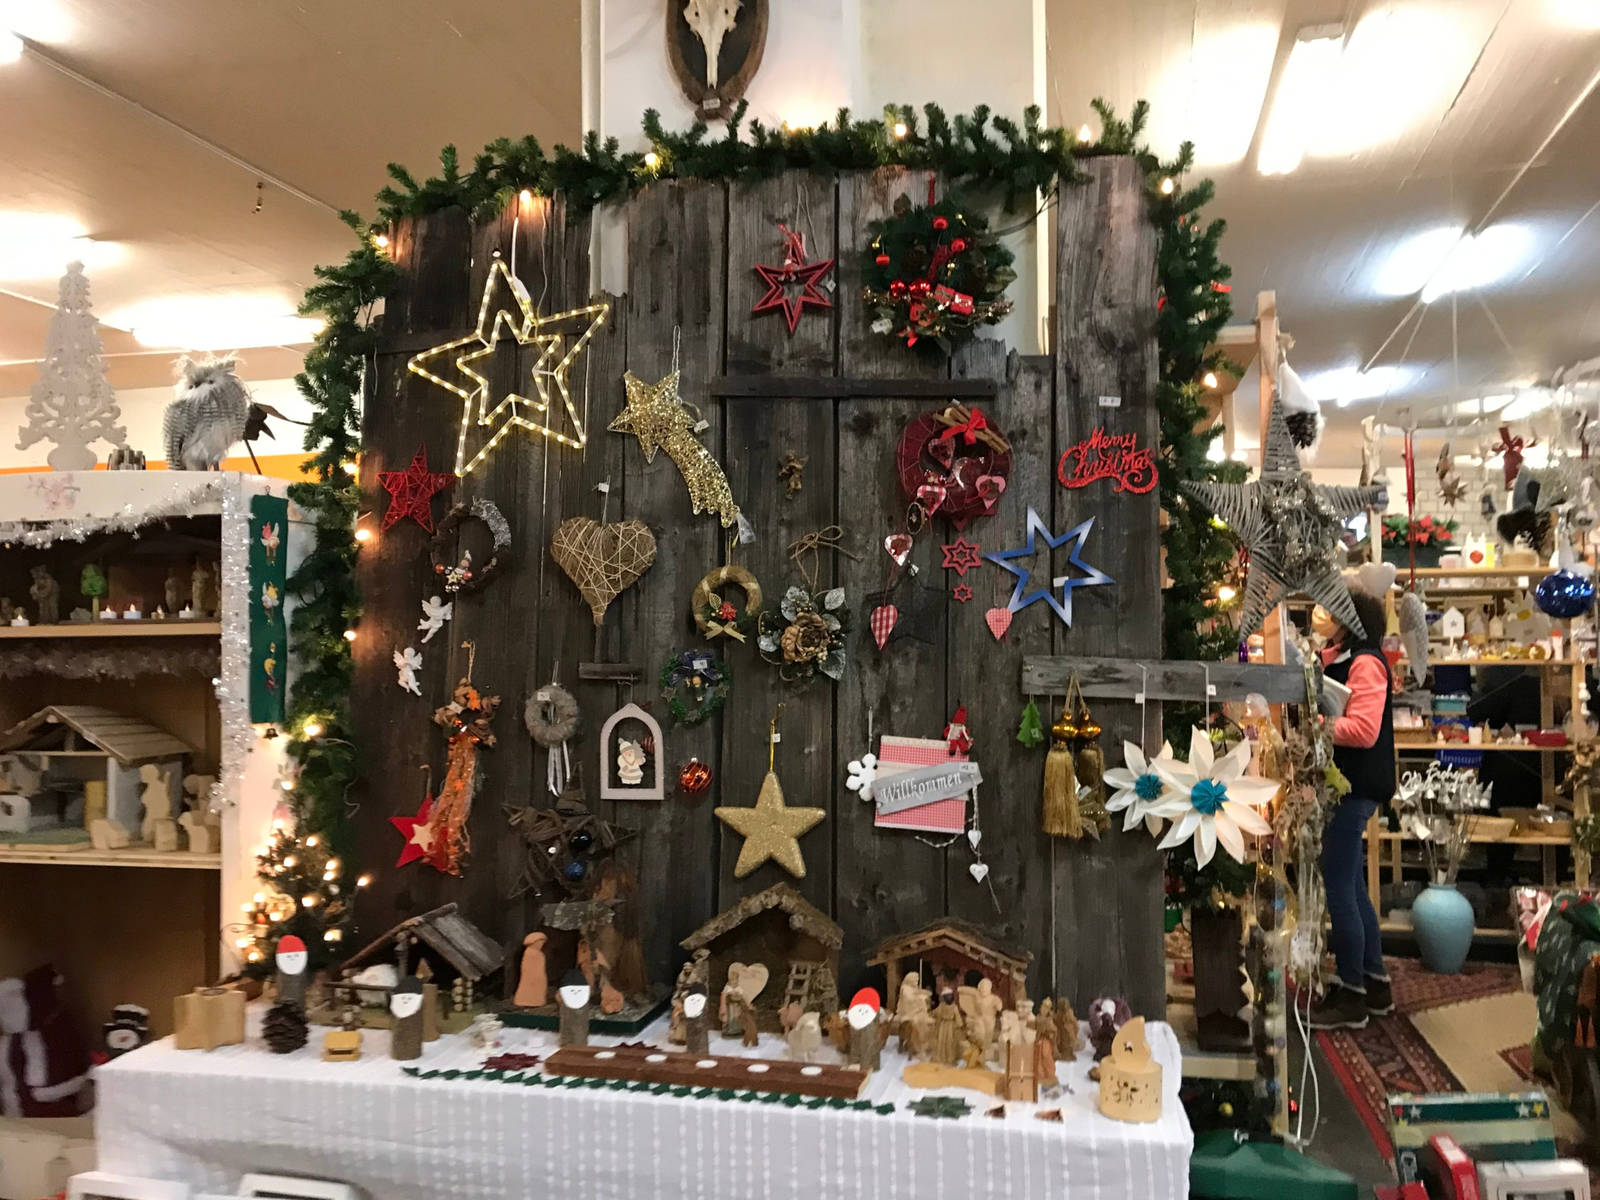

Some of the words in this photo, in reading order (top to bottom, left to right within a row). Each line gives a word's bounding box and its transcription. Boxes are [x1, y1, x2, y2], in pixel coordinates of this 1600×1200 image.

[1087, 425, 1137, 461] Merry
[1057, 441, 1159, 494] Christmas
[880, 771, 962, 803] Willkommen
